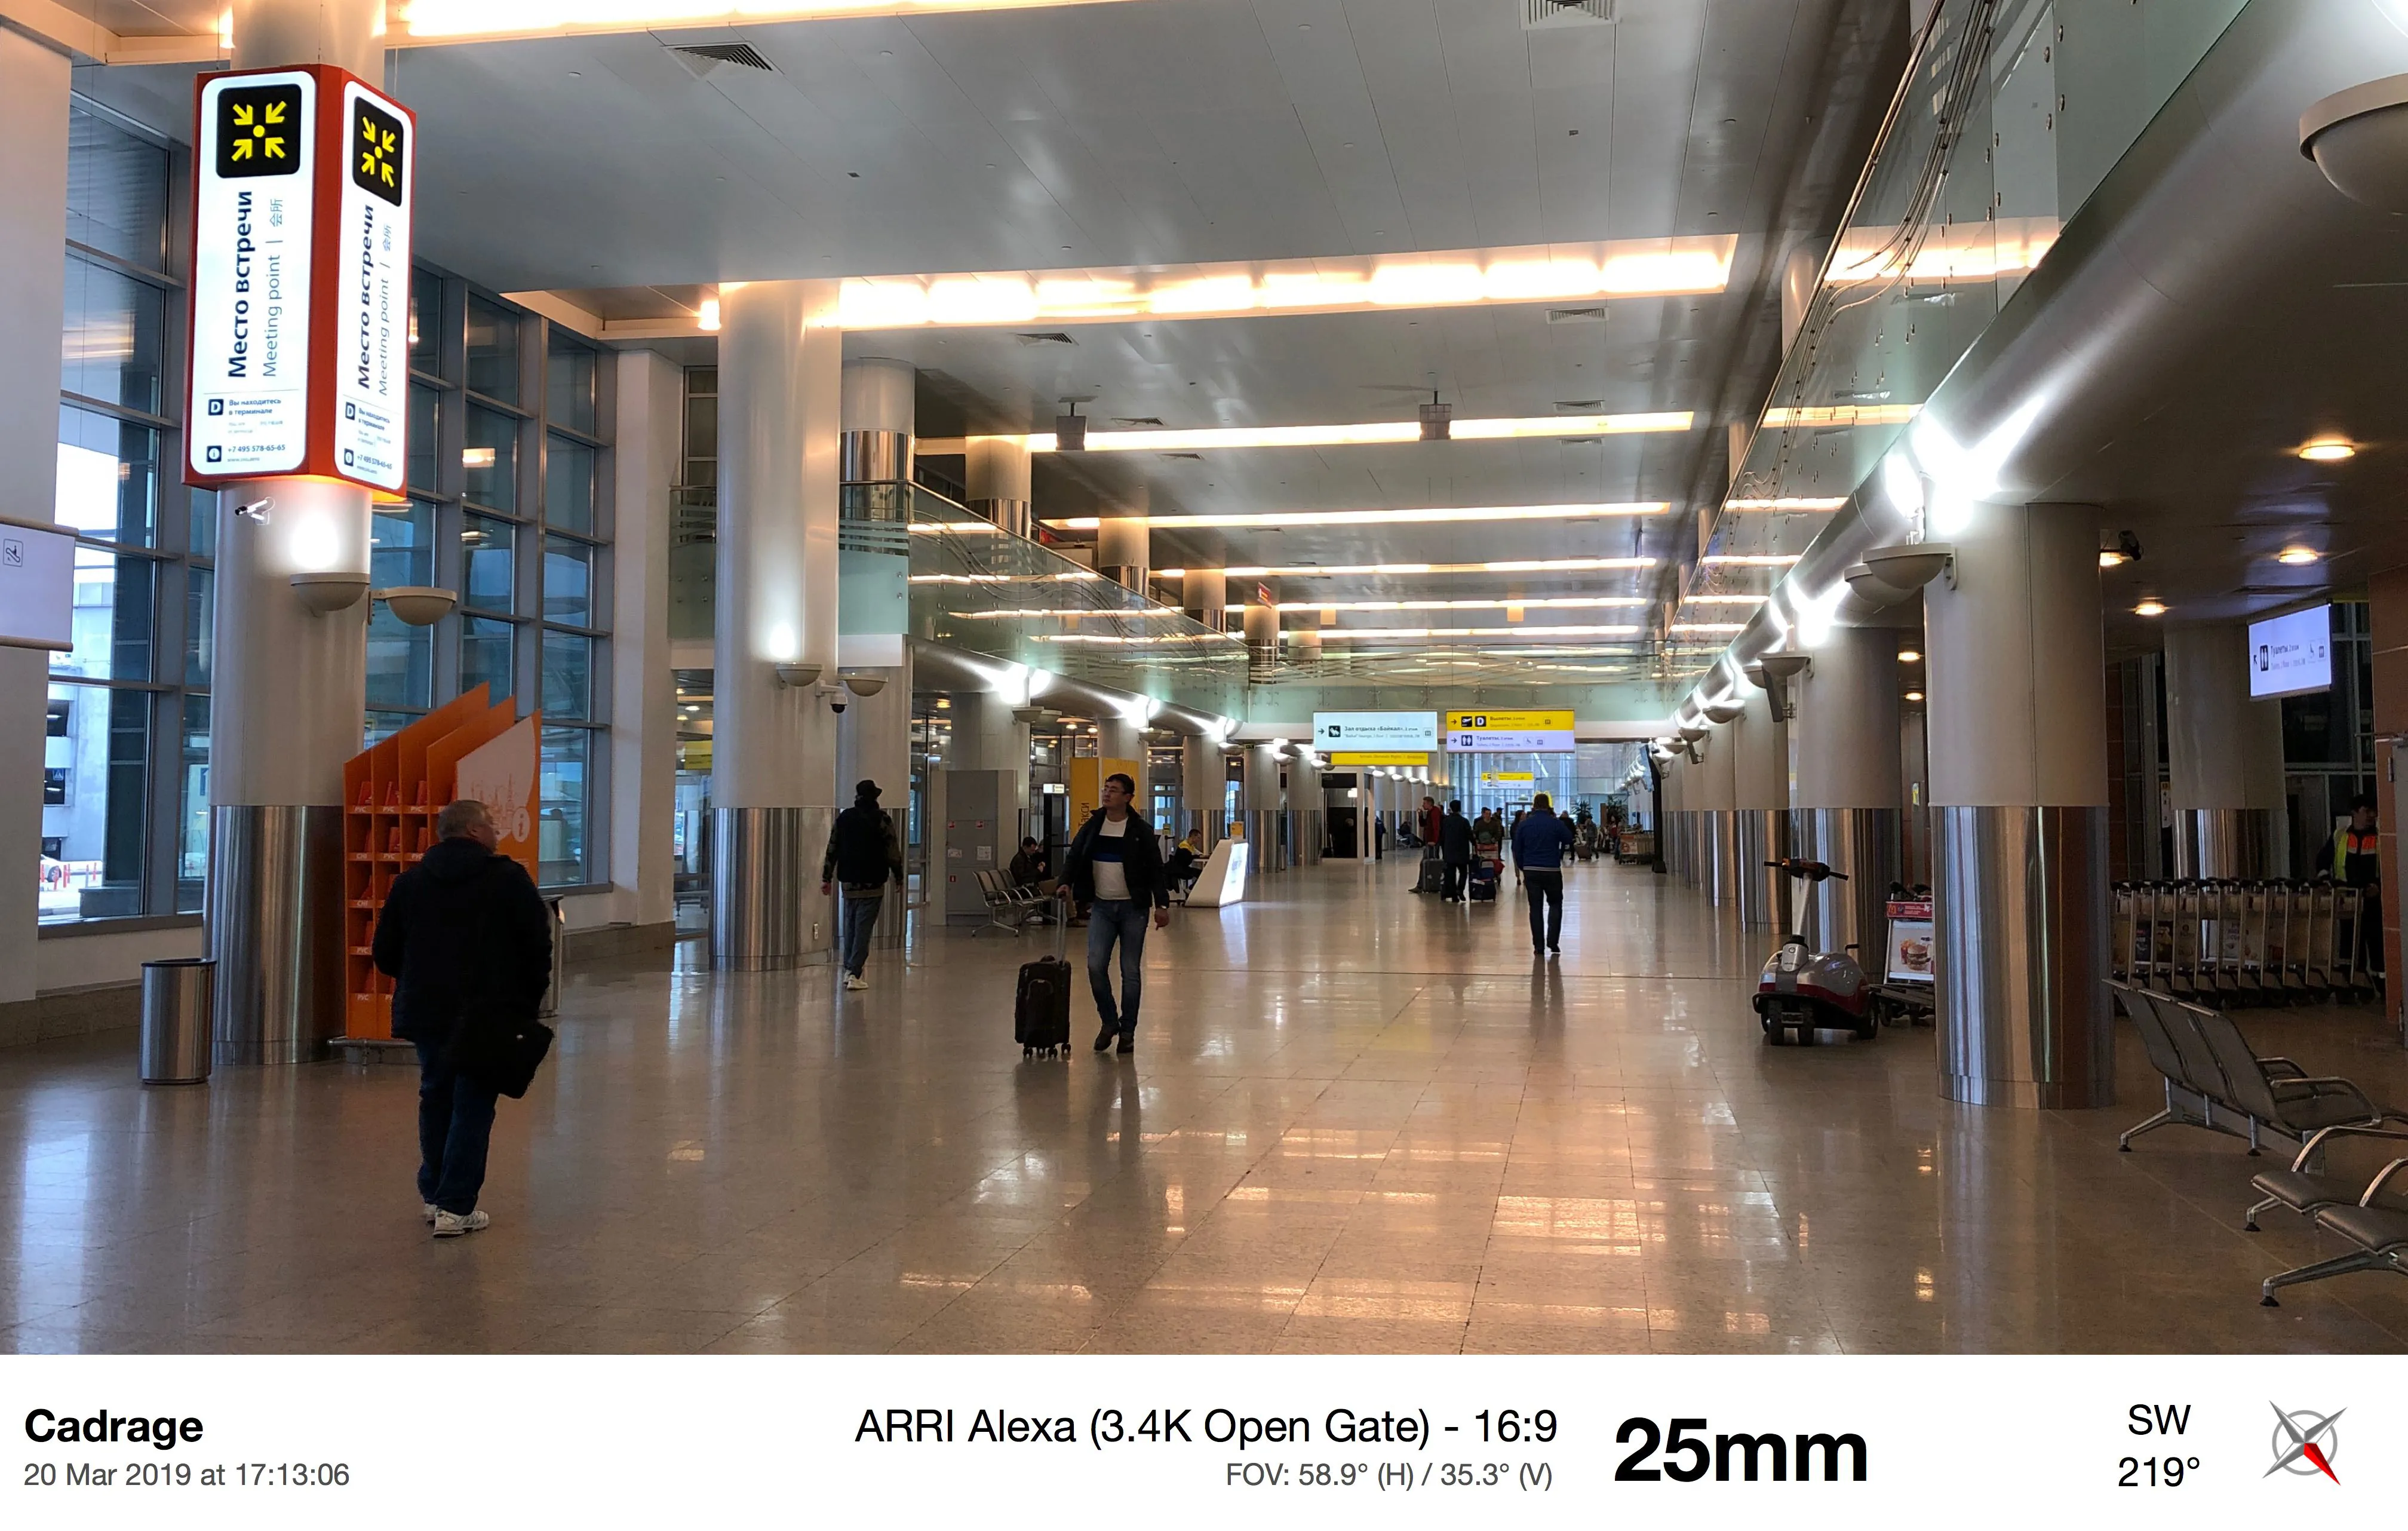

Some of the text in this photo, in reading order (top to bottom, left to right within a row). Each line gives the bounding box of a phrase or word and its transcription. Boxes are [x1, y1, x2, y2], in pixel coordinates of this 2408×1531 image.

[269, 198, 283, 227] 会所
[228, 191, 256, 378] Место встречи
[263, 254, 282, 376] Meeting point
[358, 204, 374, 389] Место встречи
[379, 277, 390, 396] Meeting point
[1477, 717, 1485, 726] D
